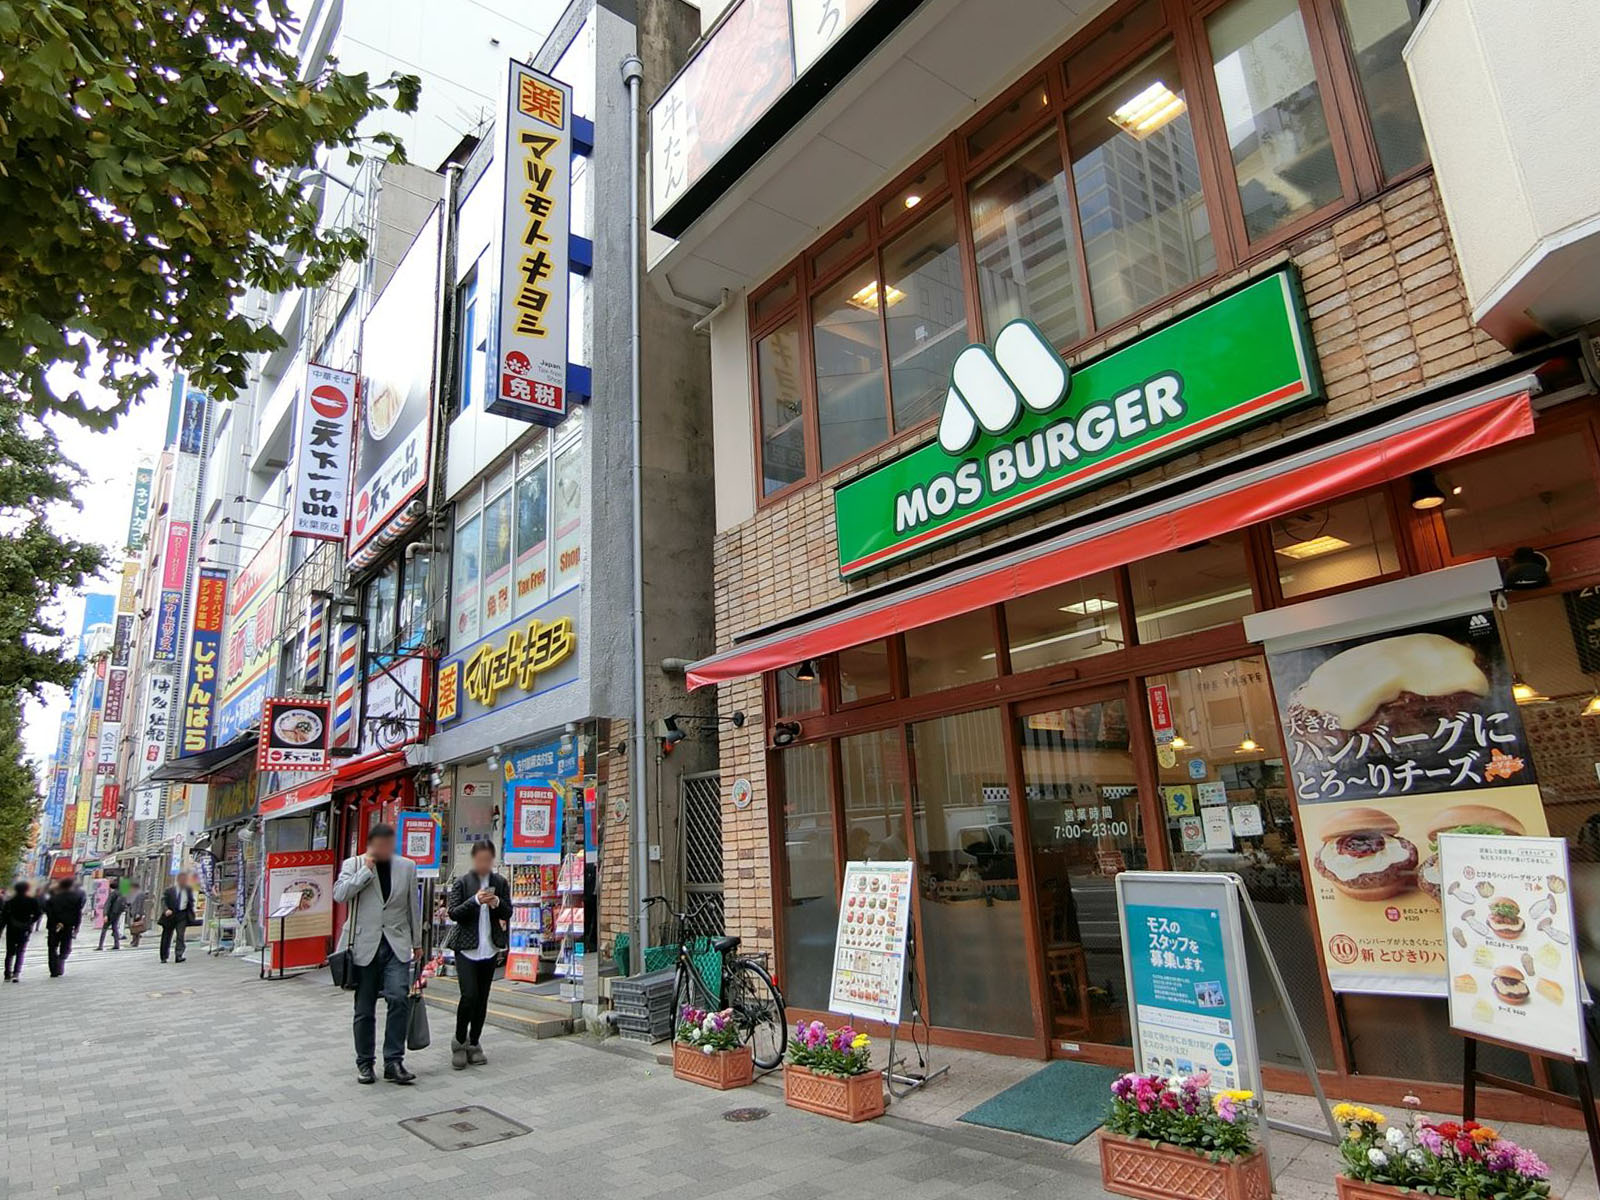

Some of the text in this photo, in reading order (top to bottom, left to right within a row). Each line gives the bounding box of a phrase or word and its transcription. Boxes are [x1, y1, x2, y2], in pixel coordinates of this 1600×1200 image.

[522, 79, 560, 125] 薬
[661, 95, 684, 199] 牛たん
[516, 131, 558, 337] マツモトキヨシ
[313, 370, 352, 385] 中華そば
[509, 377, 557, 407] 免税
[895, 375, 1184, 533] MOS BURGER
[303, 419, 344, 518] 天下一品
[299, 517, 340, 534] 秋葉原店
[517, 577, 530, 598] Tax
[465, 621, 570, 703] マツモトキヨシ
[184, 641, 216, 751] じゃんぱら
[438, 670, 457, 719] 薬
[1292, 710, 1517, 765] ハンバーグに
[98, 765, 114, 774] 3F
[283, 750, 322, 762] 天下一品
[1064, 805, 1114, 823] 営業時間
[1146, 915, 1181, 935] モスの
[1148, 932, 1200, 955] スタッフを
[1360, 948, 1375, 964] 新
[1150, 949, 1205, 974] 募集します。
